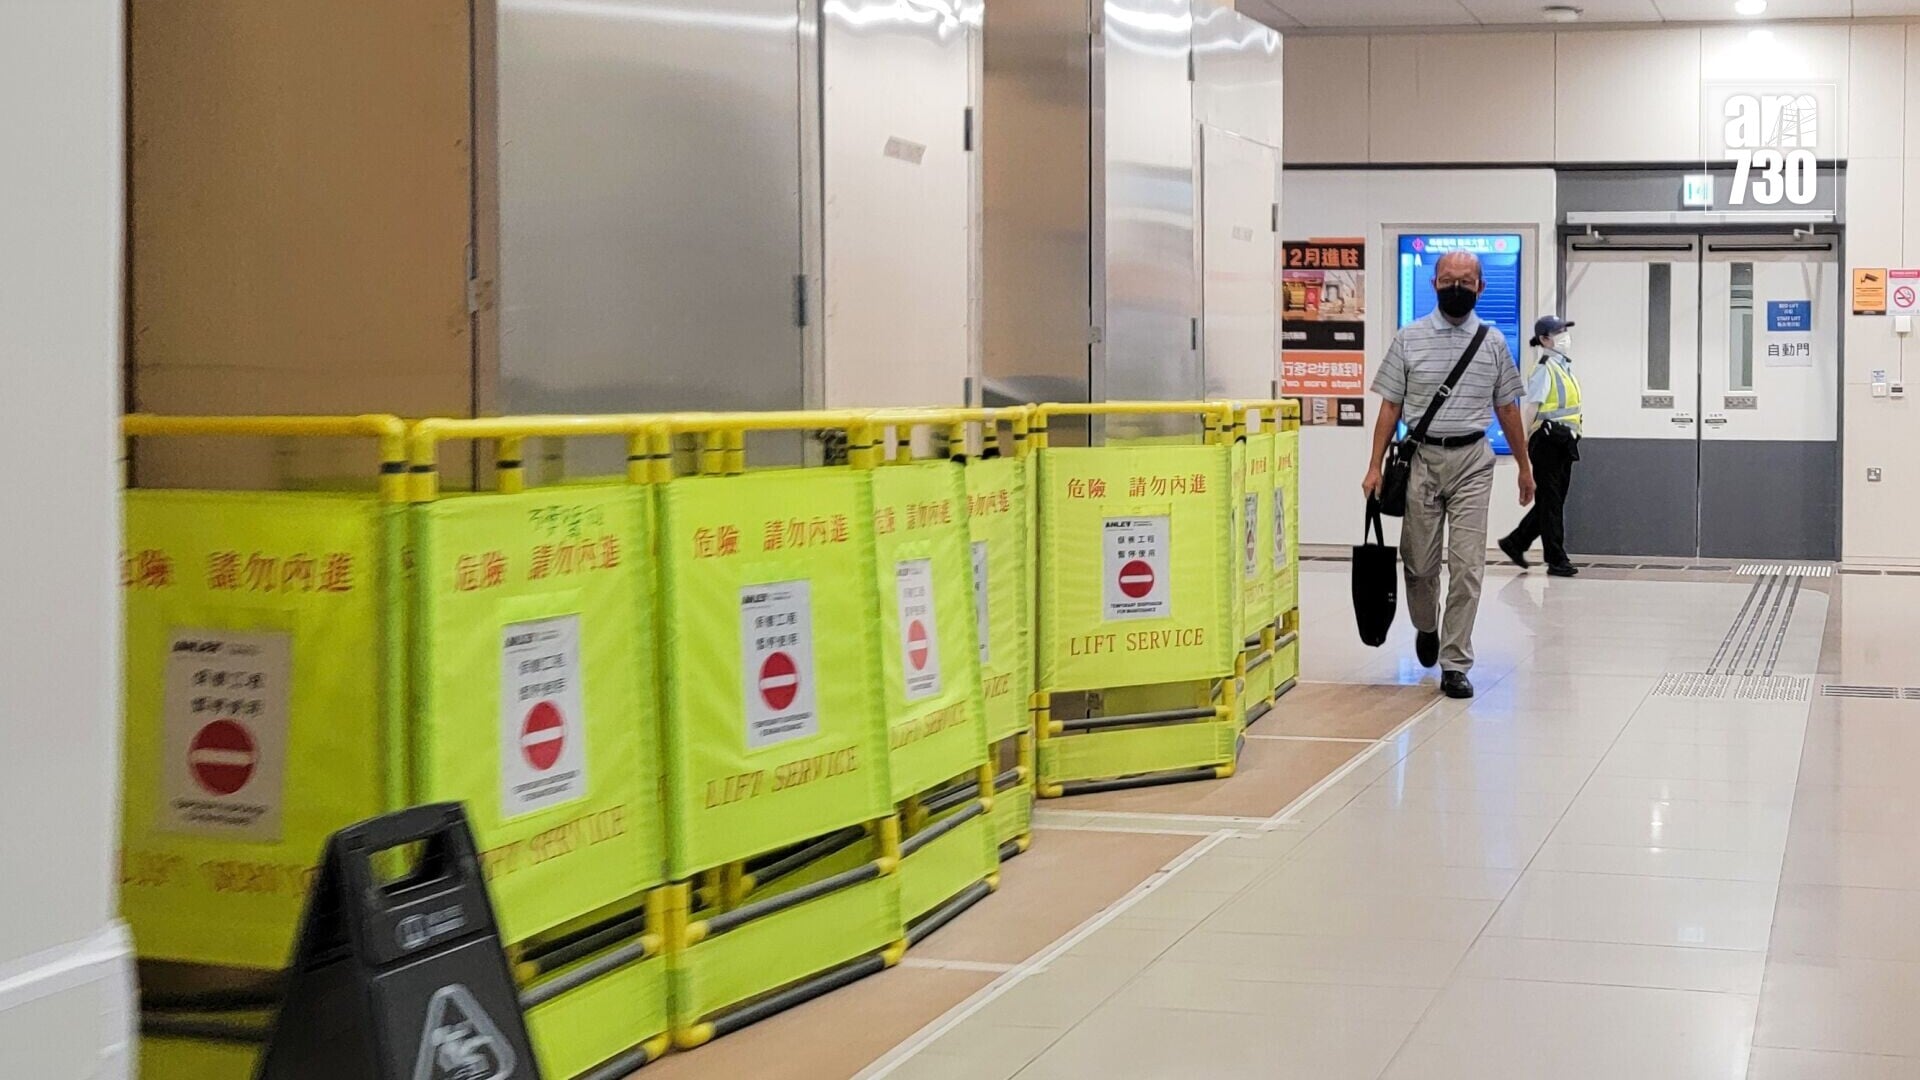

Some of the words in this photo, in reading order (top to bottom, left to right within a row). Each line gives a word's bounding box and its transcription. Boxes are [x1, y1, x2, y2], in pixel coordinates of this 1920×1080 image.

[1768, 343, 1810, 357] 自動門
[1067, 478, 1106, 498] 危險
[692, 524, 740, 559] 危險
[1070, 634, 1117, 657] LIFT
[1126, 628, 1205, 652] SERVICE
[705, 770, 764, 809] LIFT
[770, 745, 859, 793] SERVICE
